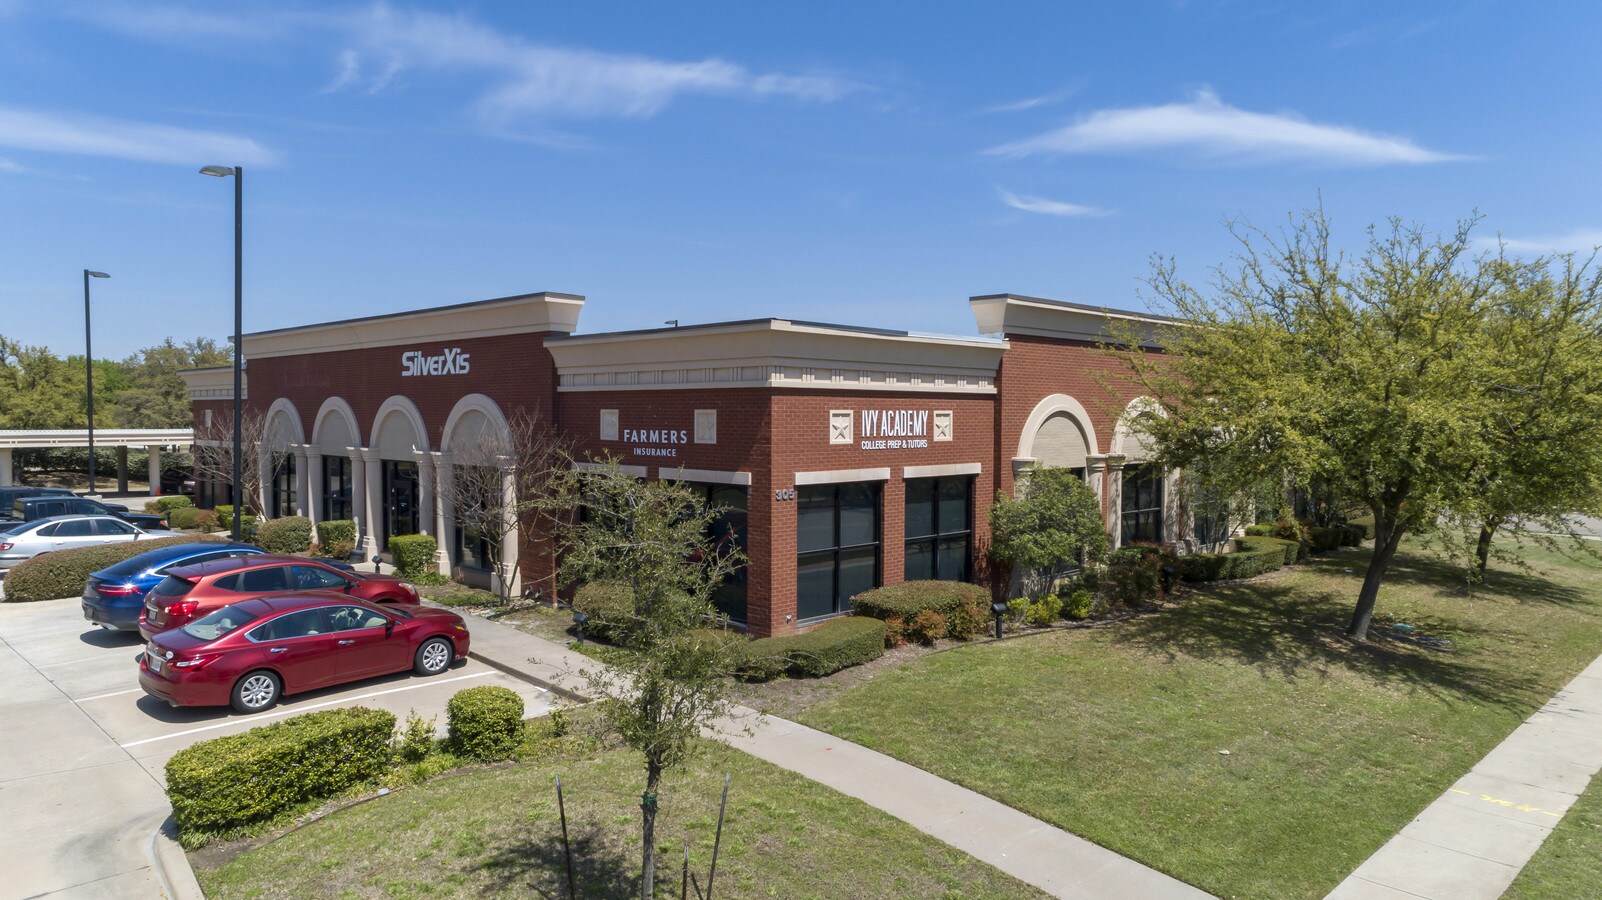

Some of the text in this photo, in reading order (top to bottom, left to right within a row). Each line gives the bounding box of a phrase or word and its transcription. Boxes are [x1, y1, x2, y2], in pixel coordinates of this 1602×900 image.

[401, 347, 470, 377] SilverXis
[861, 410, 928, 437] IVY ACADEMY
[623, 429, 688, 444] FARMERS
[861, 440, 928, 450] COLLEGE PREP & TUTORS
[633, 447, 677, 457] INSURANCE
[775, 489, 795, 500] 305
